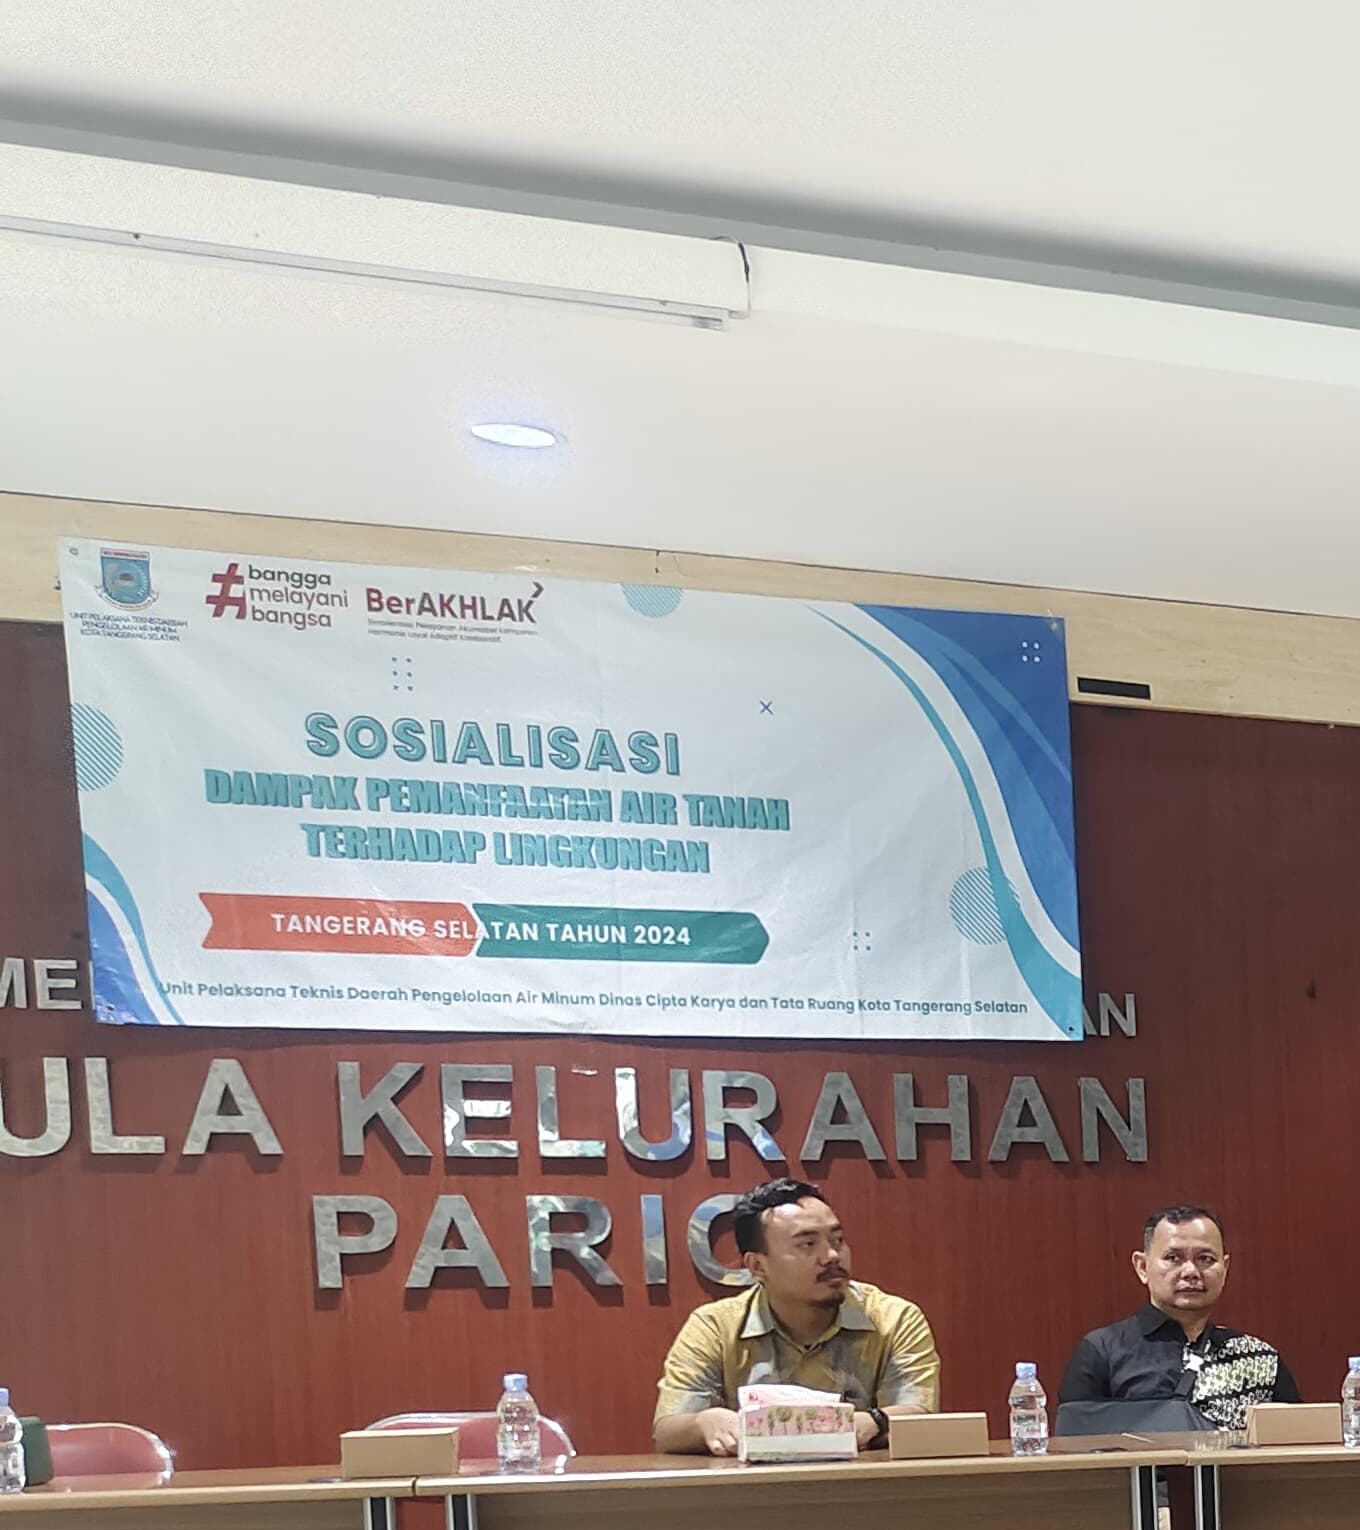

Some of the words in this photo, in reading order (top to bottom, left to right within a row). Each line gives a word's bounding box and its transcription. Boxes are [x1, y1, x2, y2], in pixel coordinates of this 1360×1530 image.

[248, 565, 331, 589] bangga
[250, 586, 348, 610] melayani
[366, 587, 536, 623] BerAKHLAK
[252, 604, 331, 630] bangsa
[305, 712, 680, 776] SOSIALISASI
[204, 768, 360, 810] DAMPAK
[365, 777, 612, 822] PEMANFAATAN
[619, 790, 678, 825] AIR
[682, 794, 790, 831] TANAH
[300, 823, 486, 864] TERHADAP
[493, 832, 710, 873] LINGKUNGAN
[271, 913, 426, 936] TANGERANG
[434, 918, 538, 941] SELATAN
[546, 923, 627, 944] TAHUN
[634, 926, 691, 945] 2024
[0, 957, 95, 1010] ME
[159, 981, 193, 996] Unit
[198, 983, 286, 998] Pelaksana
[290, 985, 344, 1000] Teknis
[347, 986, 408, 1001] Daerah
[412, 988, 512, 1006] Pengelolaan
[516, 990, 538, 1004] Air
[541, 991, 596, 1006] Minum
[599, 993, 642, 1006] Dinas
[645, 993, 687, 1010] Cipta
[691, 995, 735, 1012] Karya
[739, 996, 768, 1010] dan
[771, 997, 804, 1010] Tata
[807, 998, 854, 1014] Ruang
[858, 1000, 890, 1012] Kota
[894, 1000, 972, 1016] Tangerang
[975, 1000, 1028, 1014] Selatan
[337, 1061, 1148, 1162] KELURAHAN
